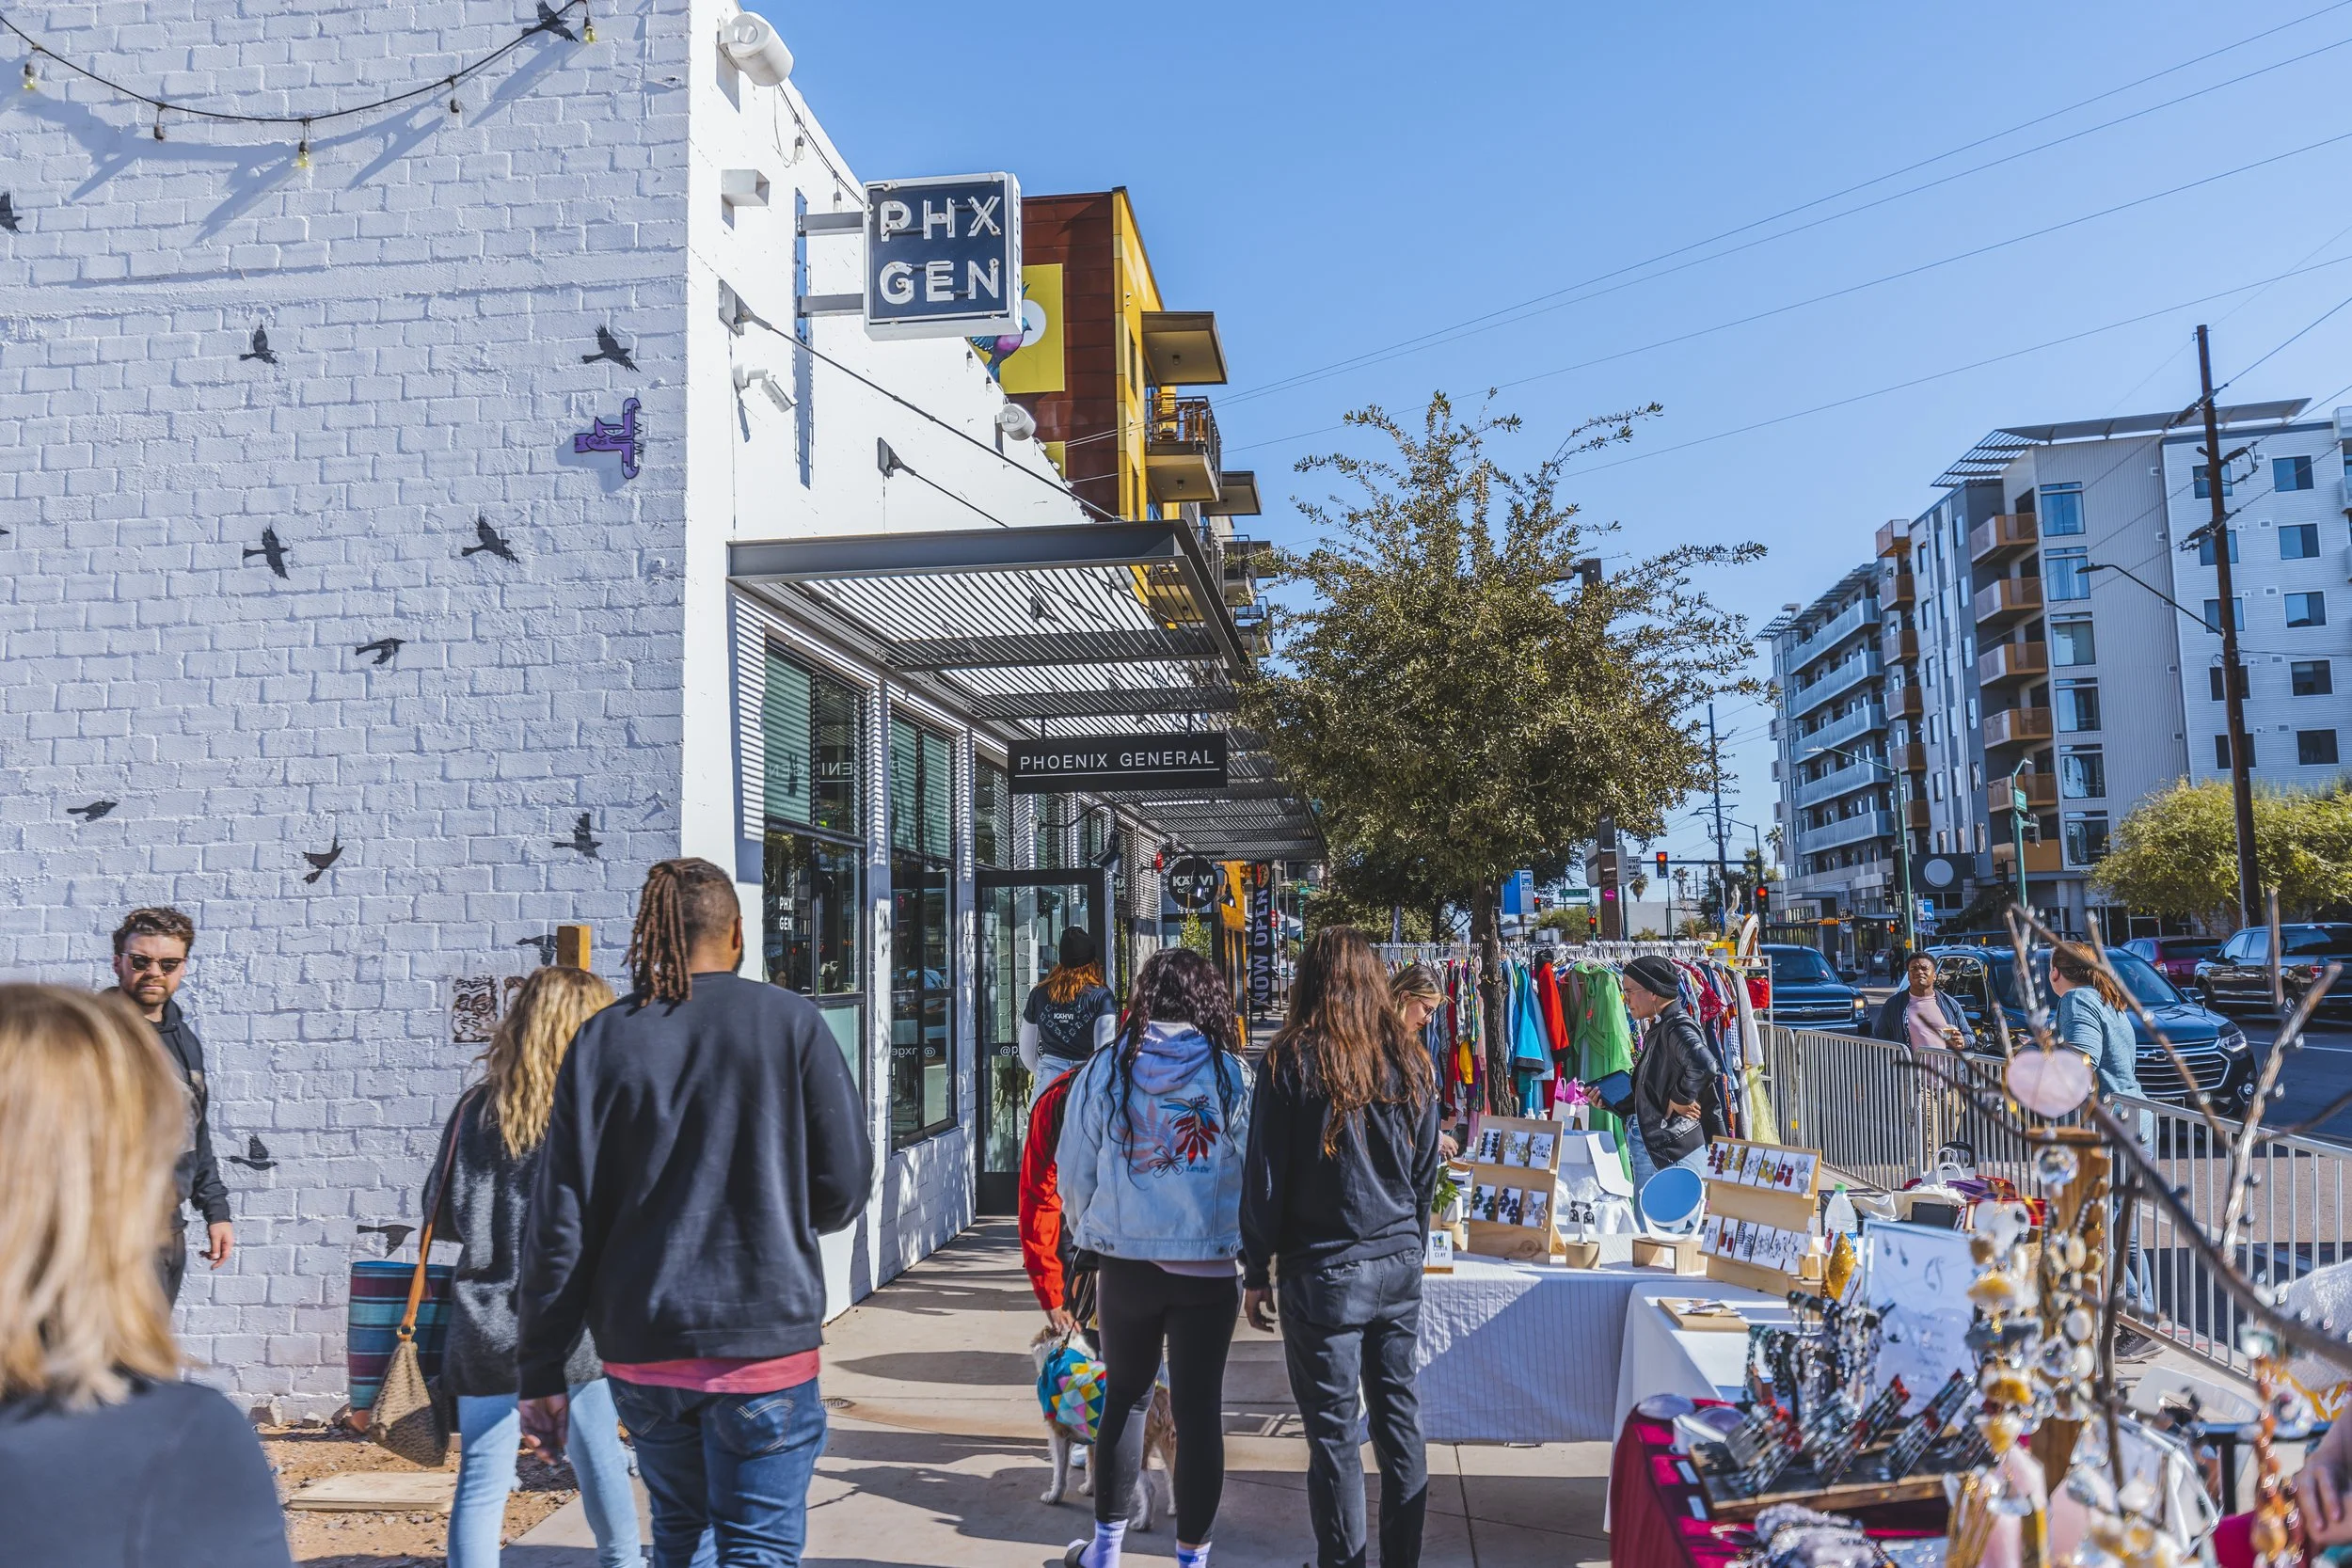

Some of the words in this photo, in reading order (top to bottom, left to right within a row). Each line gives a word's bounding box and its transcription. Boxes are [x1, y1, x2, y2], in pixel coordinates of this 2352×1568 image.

[880, 196, 1001, 242] PHX
[880, 258, 999, 304] GEN
[1020, 753, 1108, 770] PHOENIX
[1120, 750, 1215, 768] GENERAL
[1172, 875, 1214, 887] KÄVI
[779, 895, 793, 911] PHX
[1254, 889, 1268, 946] OPEN
[779, 916, 793, 930] GEN
[1254, 955, 1269, 1006] NOW
